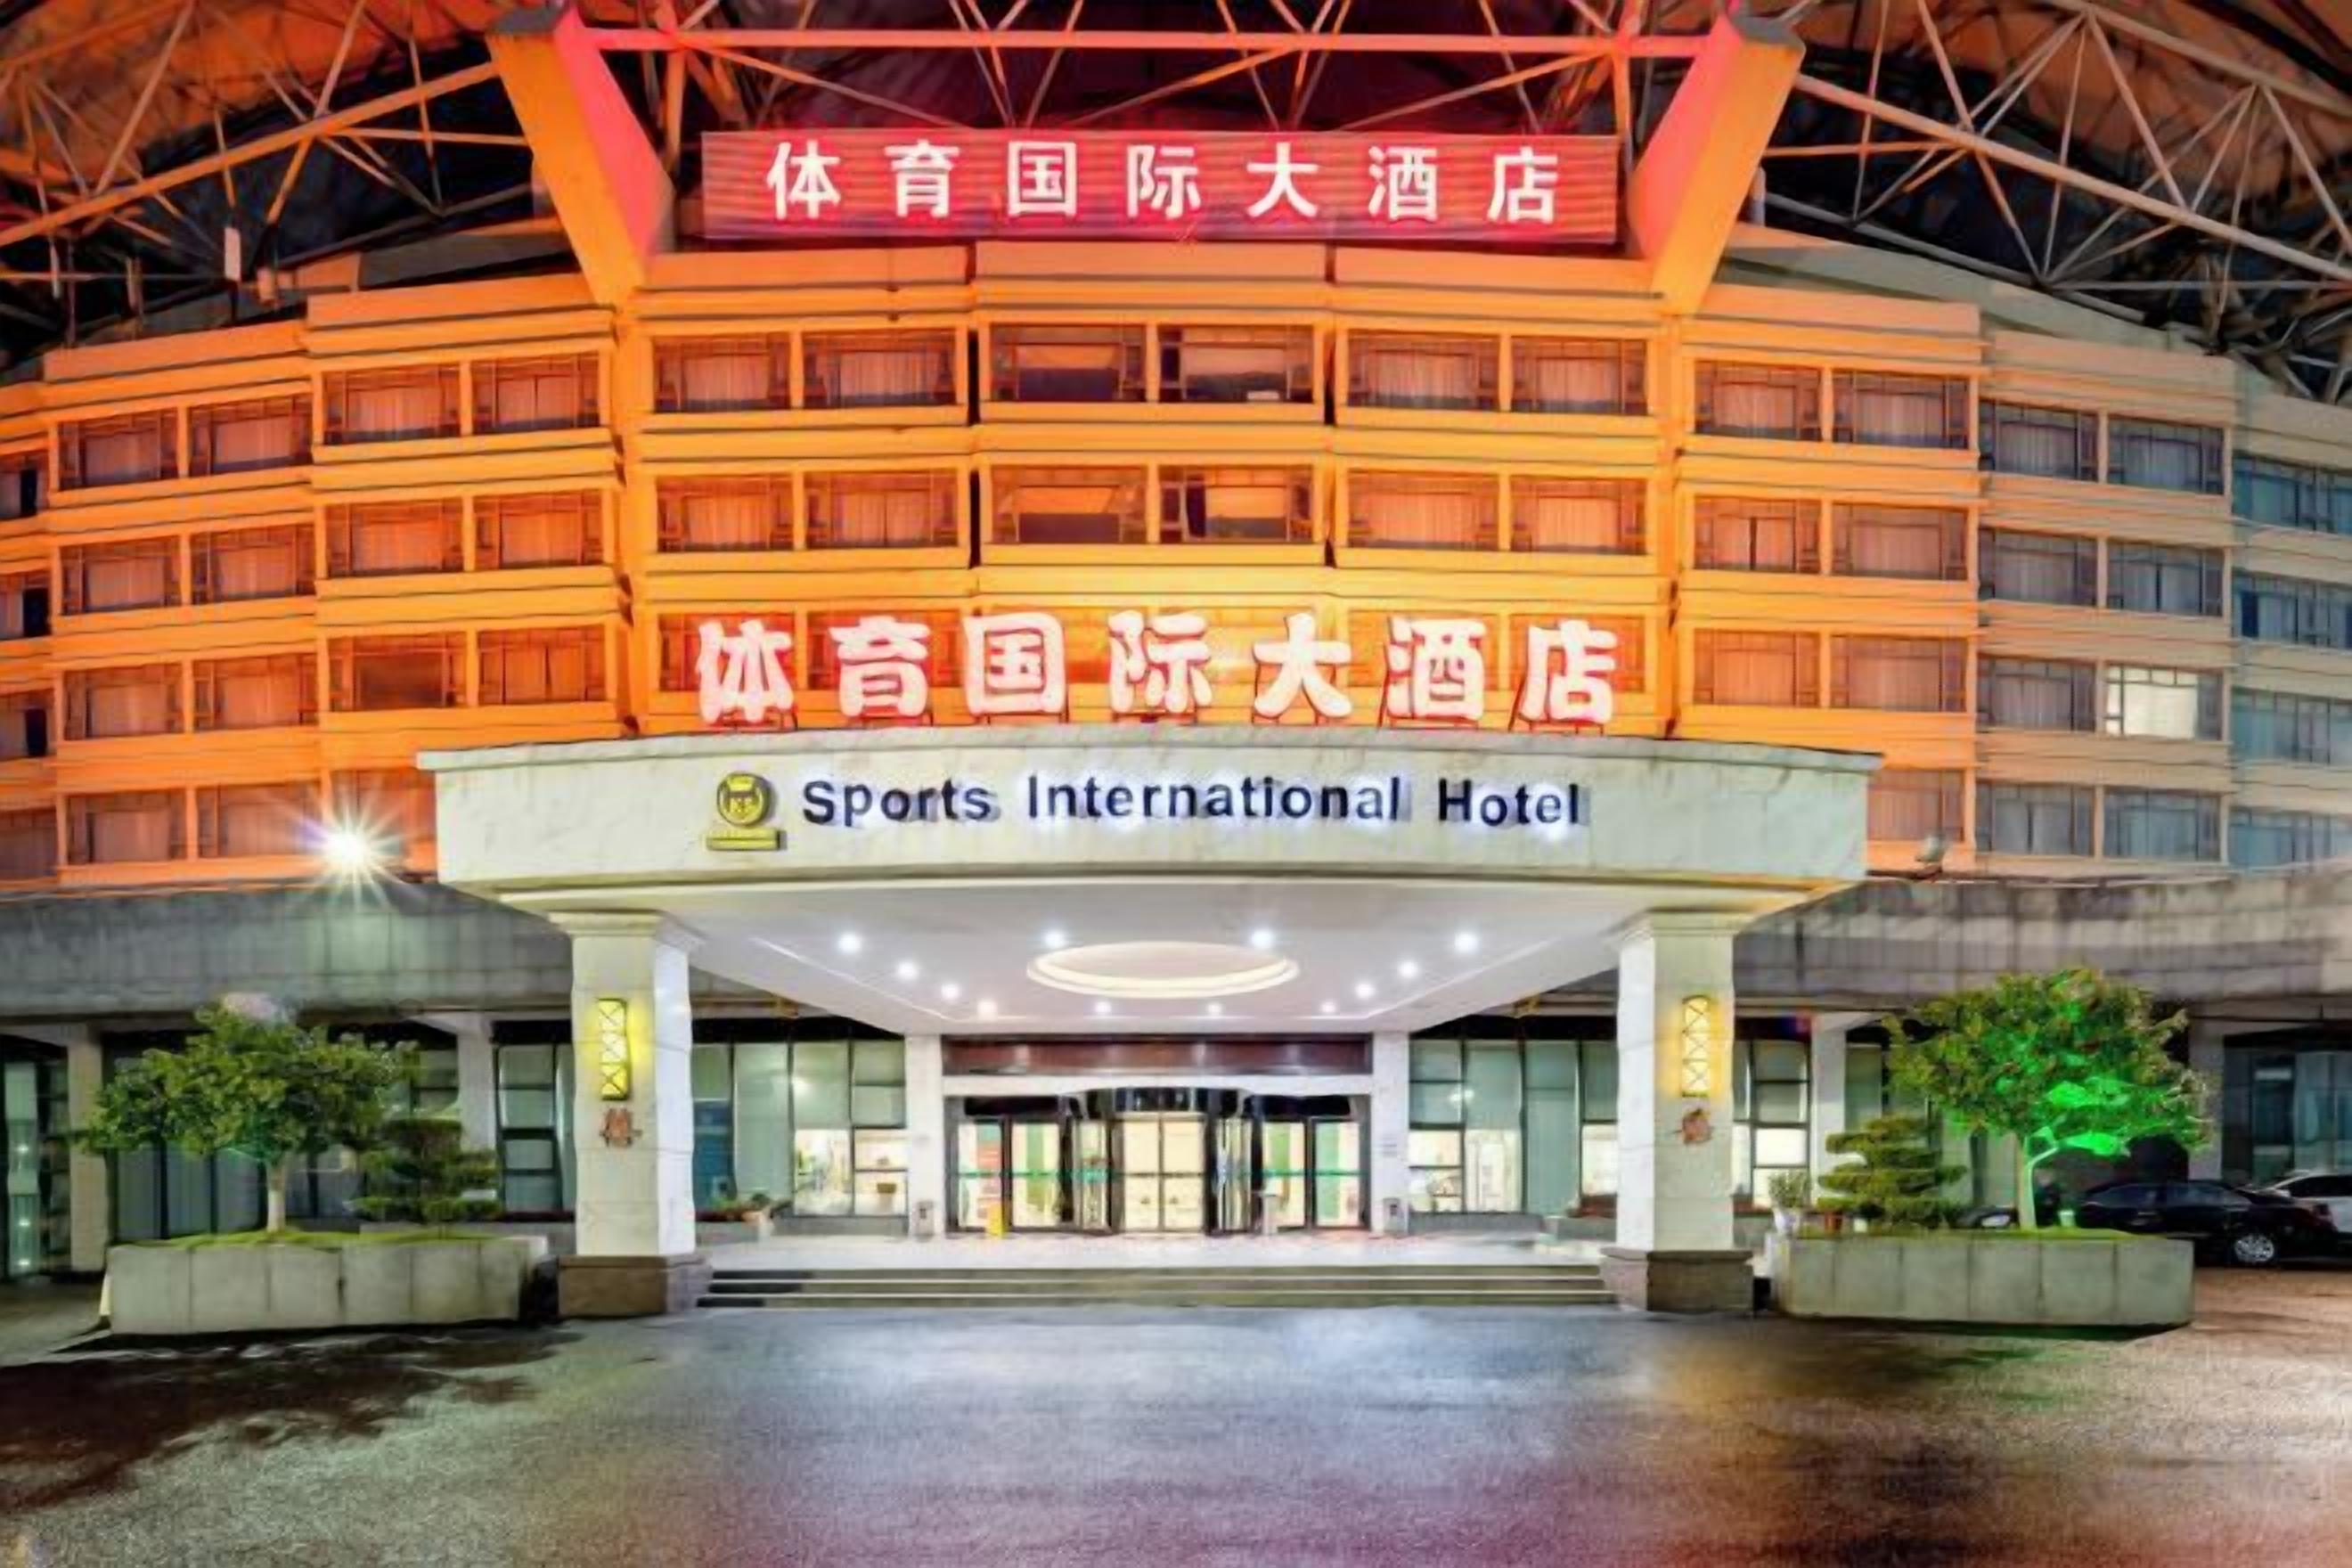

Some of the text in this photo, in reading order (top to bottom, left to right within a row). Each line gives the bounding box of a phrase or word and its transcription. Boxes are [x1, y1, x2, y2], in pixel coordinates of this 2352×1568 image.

[765, 140, 1560, 225] 体育国际大酒店
[696, 611, 1618, 724] 体育国际大酒店
[802, 774, 1579, 827] Sports International Hotel
